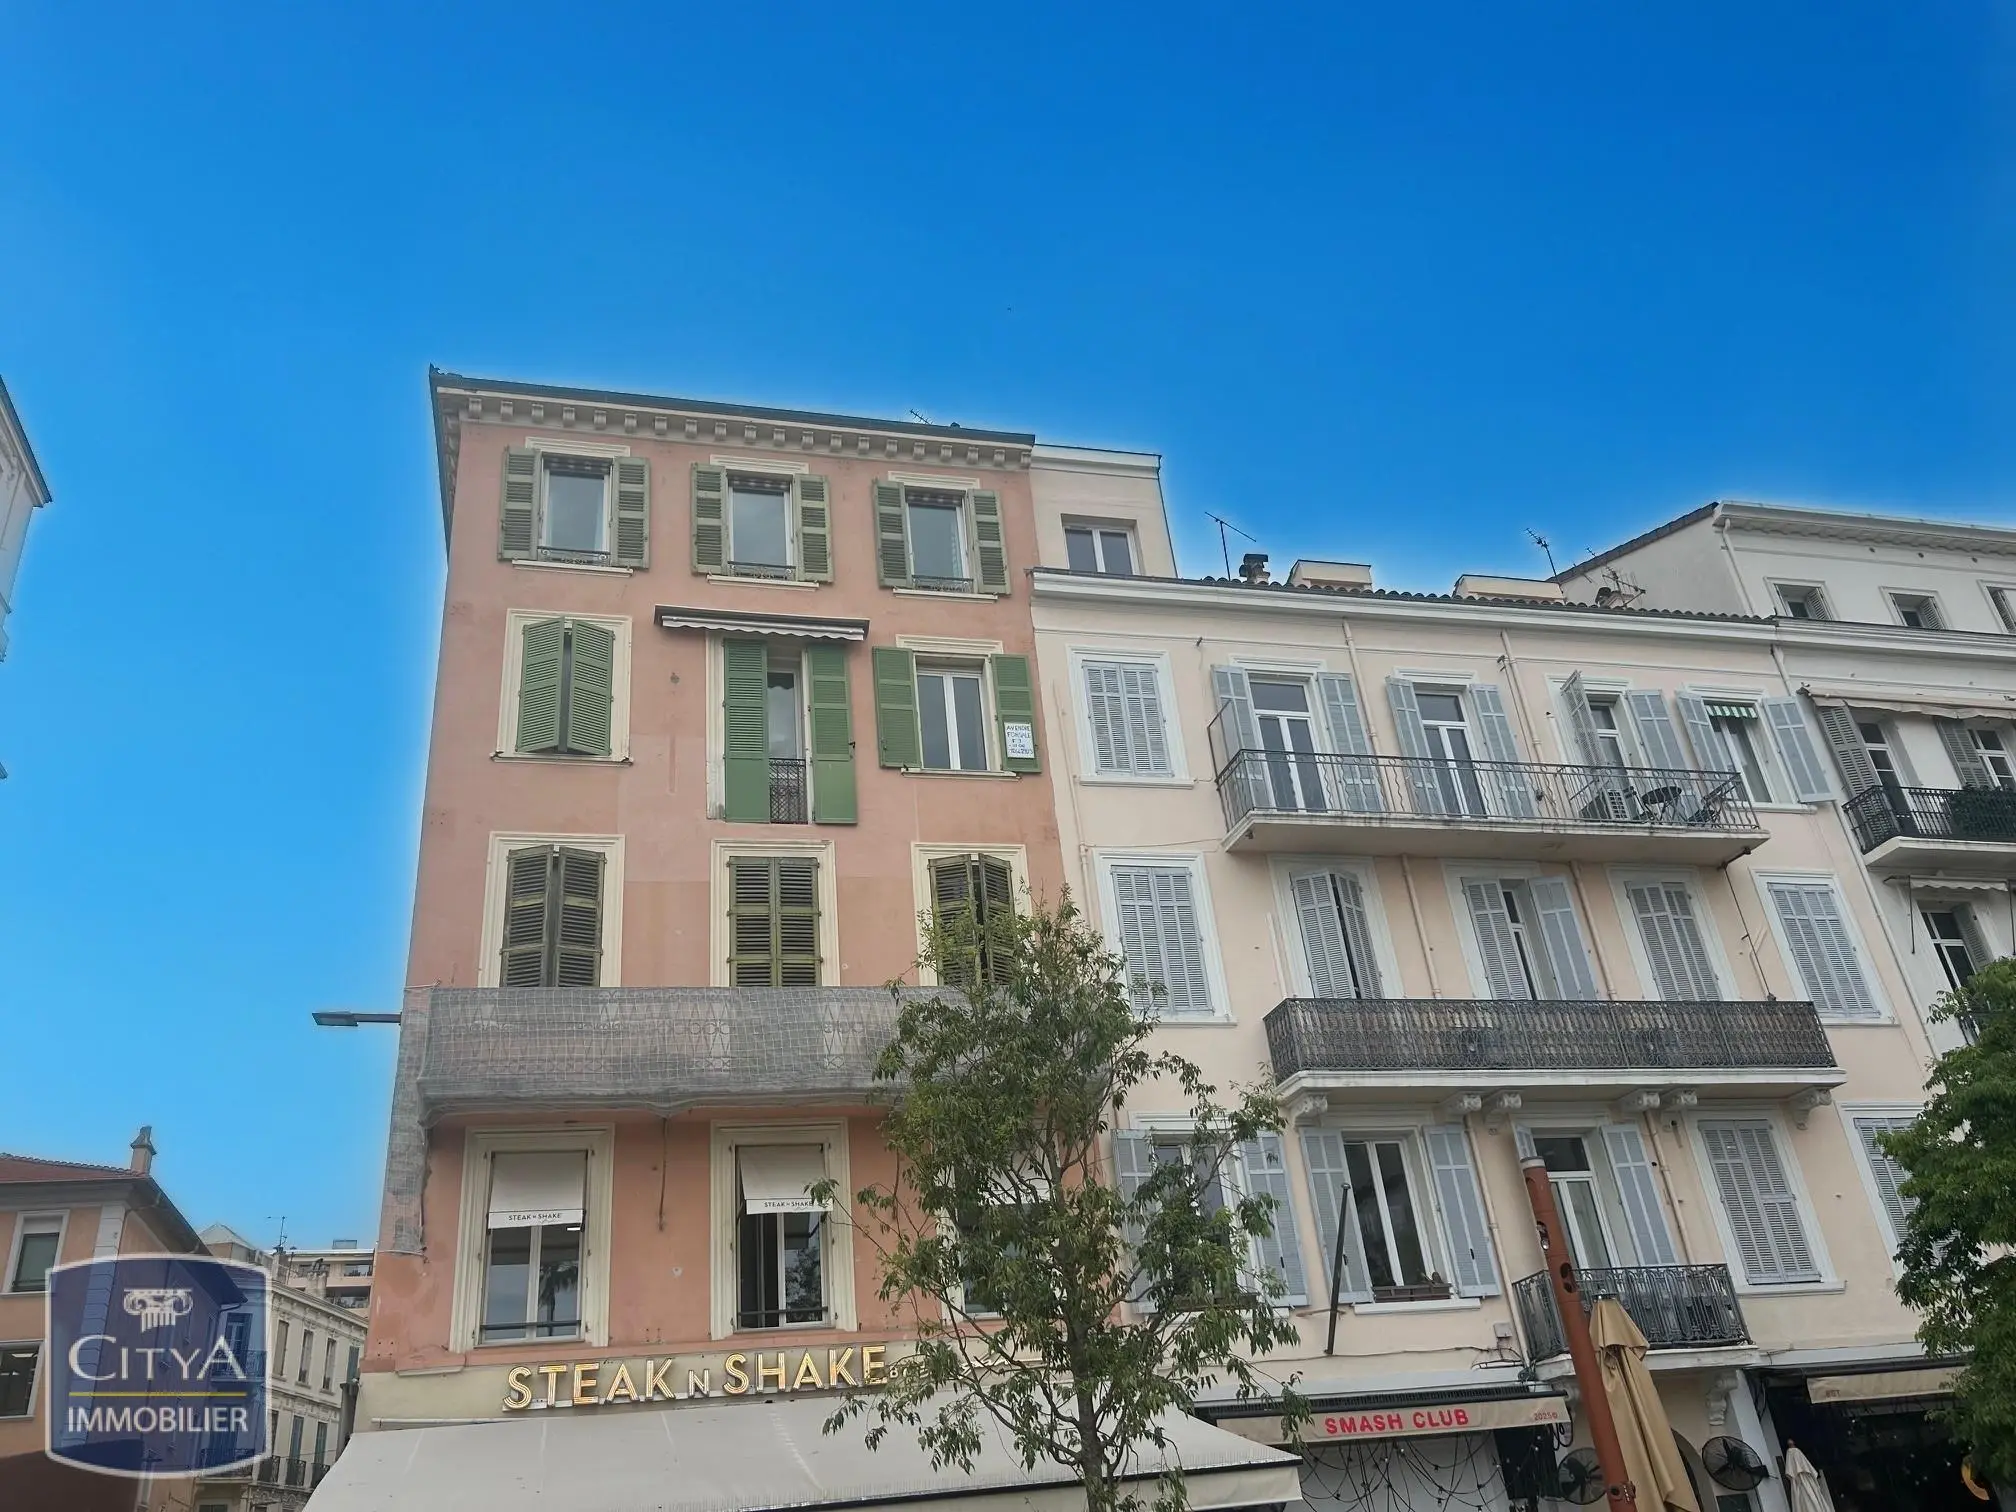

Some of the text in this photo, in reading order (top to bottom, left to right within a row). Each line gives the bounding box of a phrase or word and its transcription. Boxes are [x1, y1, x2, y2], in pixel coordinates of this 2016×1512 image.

[502, 1358, 676, 1410] STEAK
[686, 1368, 711, 1398] N
[723, 1345, 888, 1395] SHAKE
[1324, 1408, 1470, 1435] SMASH CLUB
